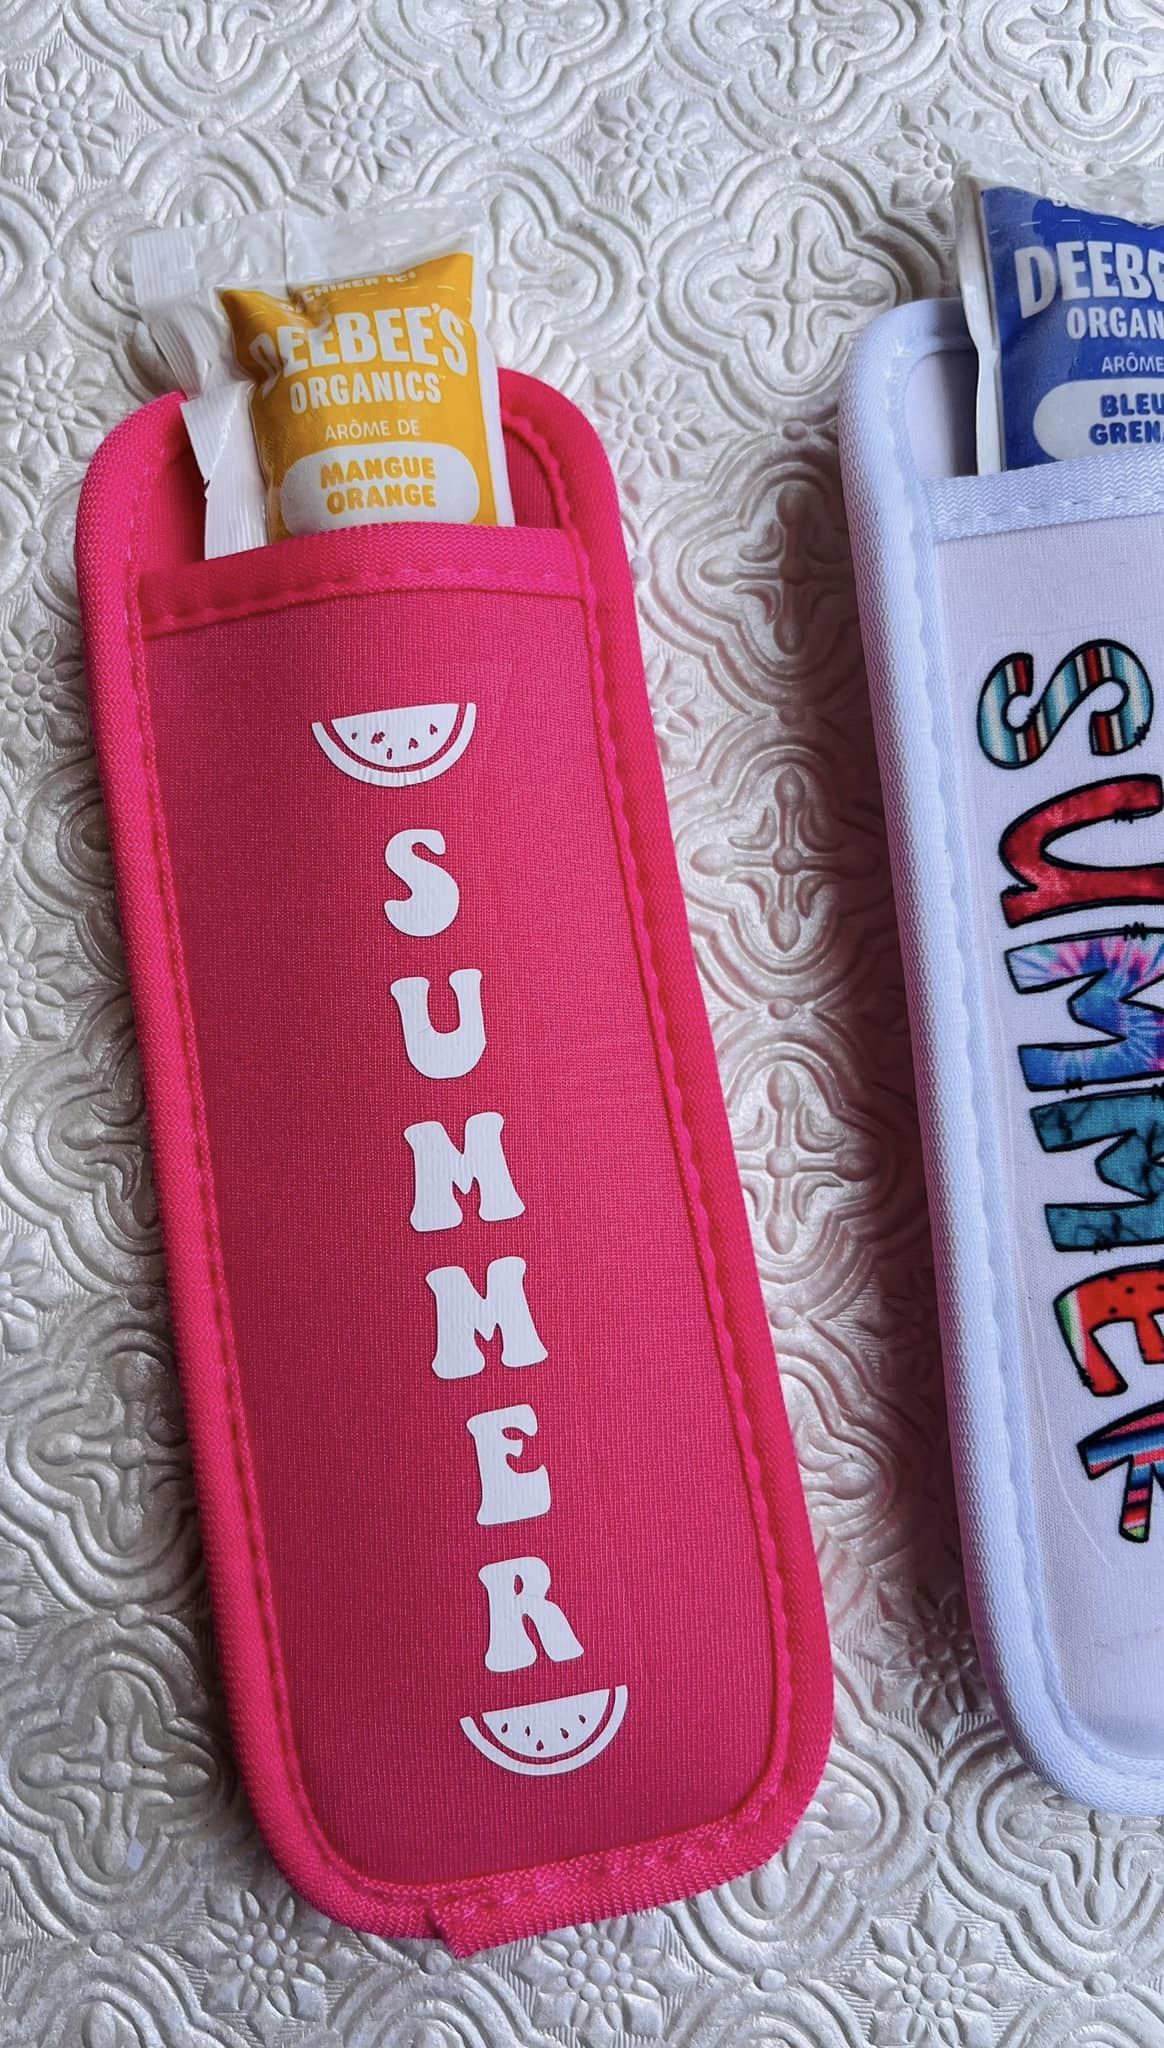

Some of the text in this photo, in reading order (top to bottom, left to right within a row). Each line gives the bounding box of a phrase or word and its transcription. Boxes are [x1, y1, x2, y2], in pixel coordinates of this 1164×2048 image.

[1101, 352, 1164, 373] ARÔME
[290, 371, 442, 414] ORGANICS
[325, 418, 421, 441] ARÔME DE
[1089, 420, 1164, 446] GREN
[320, 456, 436, 490] MANGUE
[326, 483, 436, 515] ORANGE
[383, 828, 584, 1673] SUMMER
